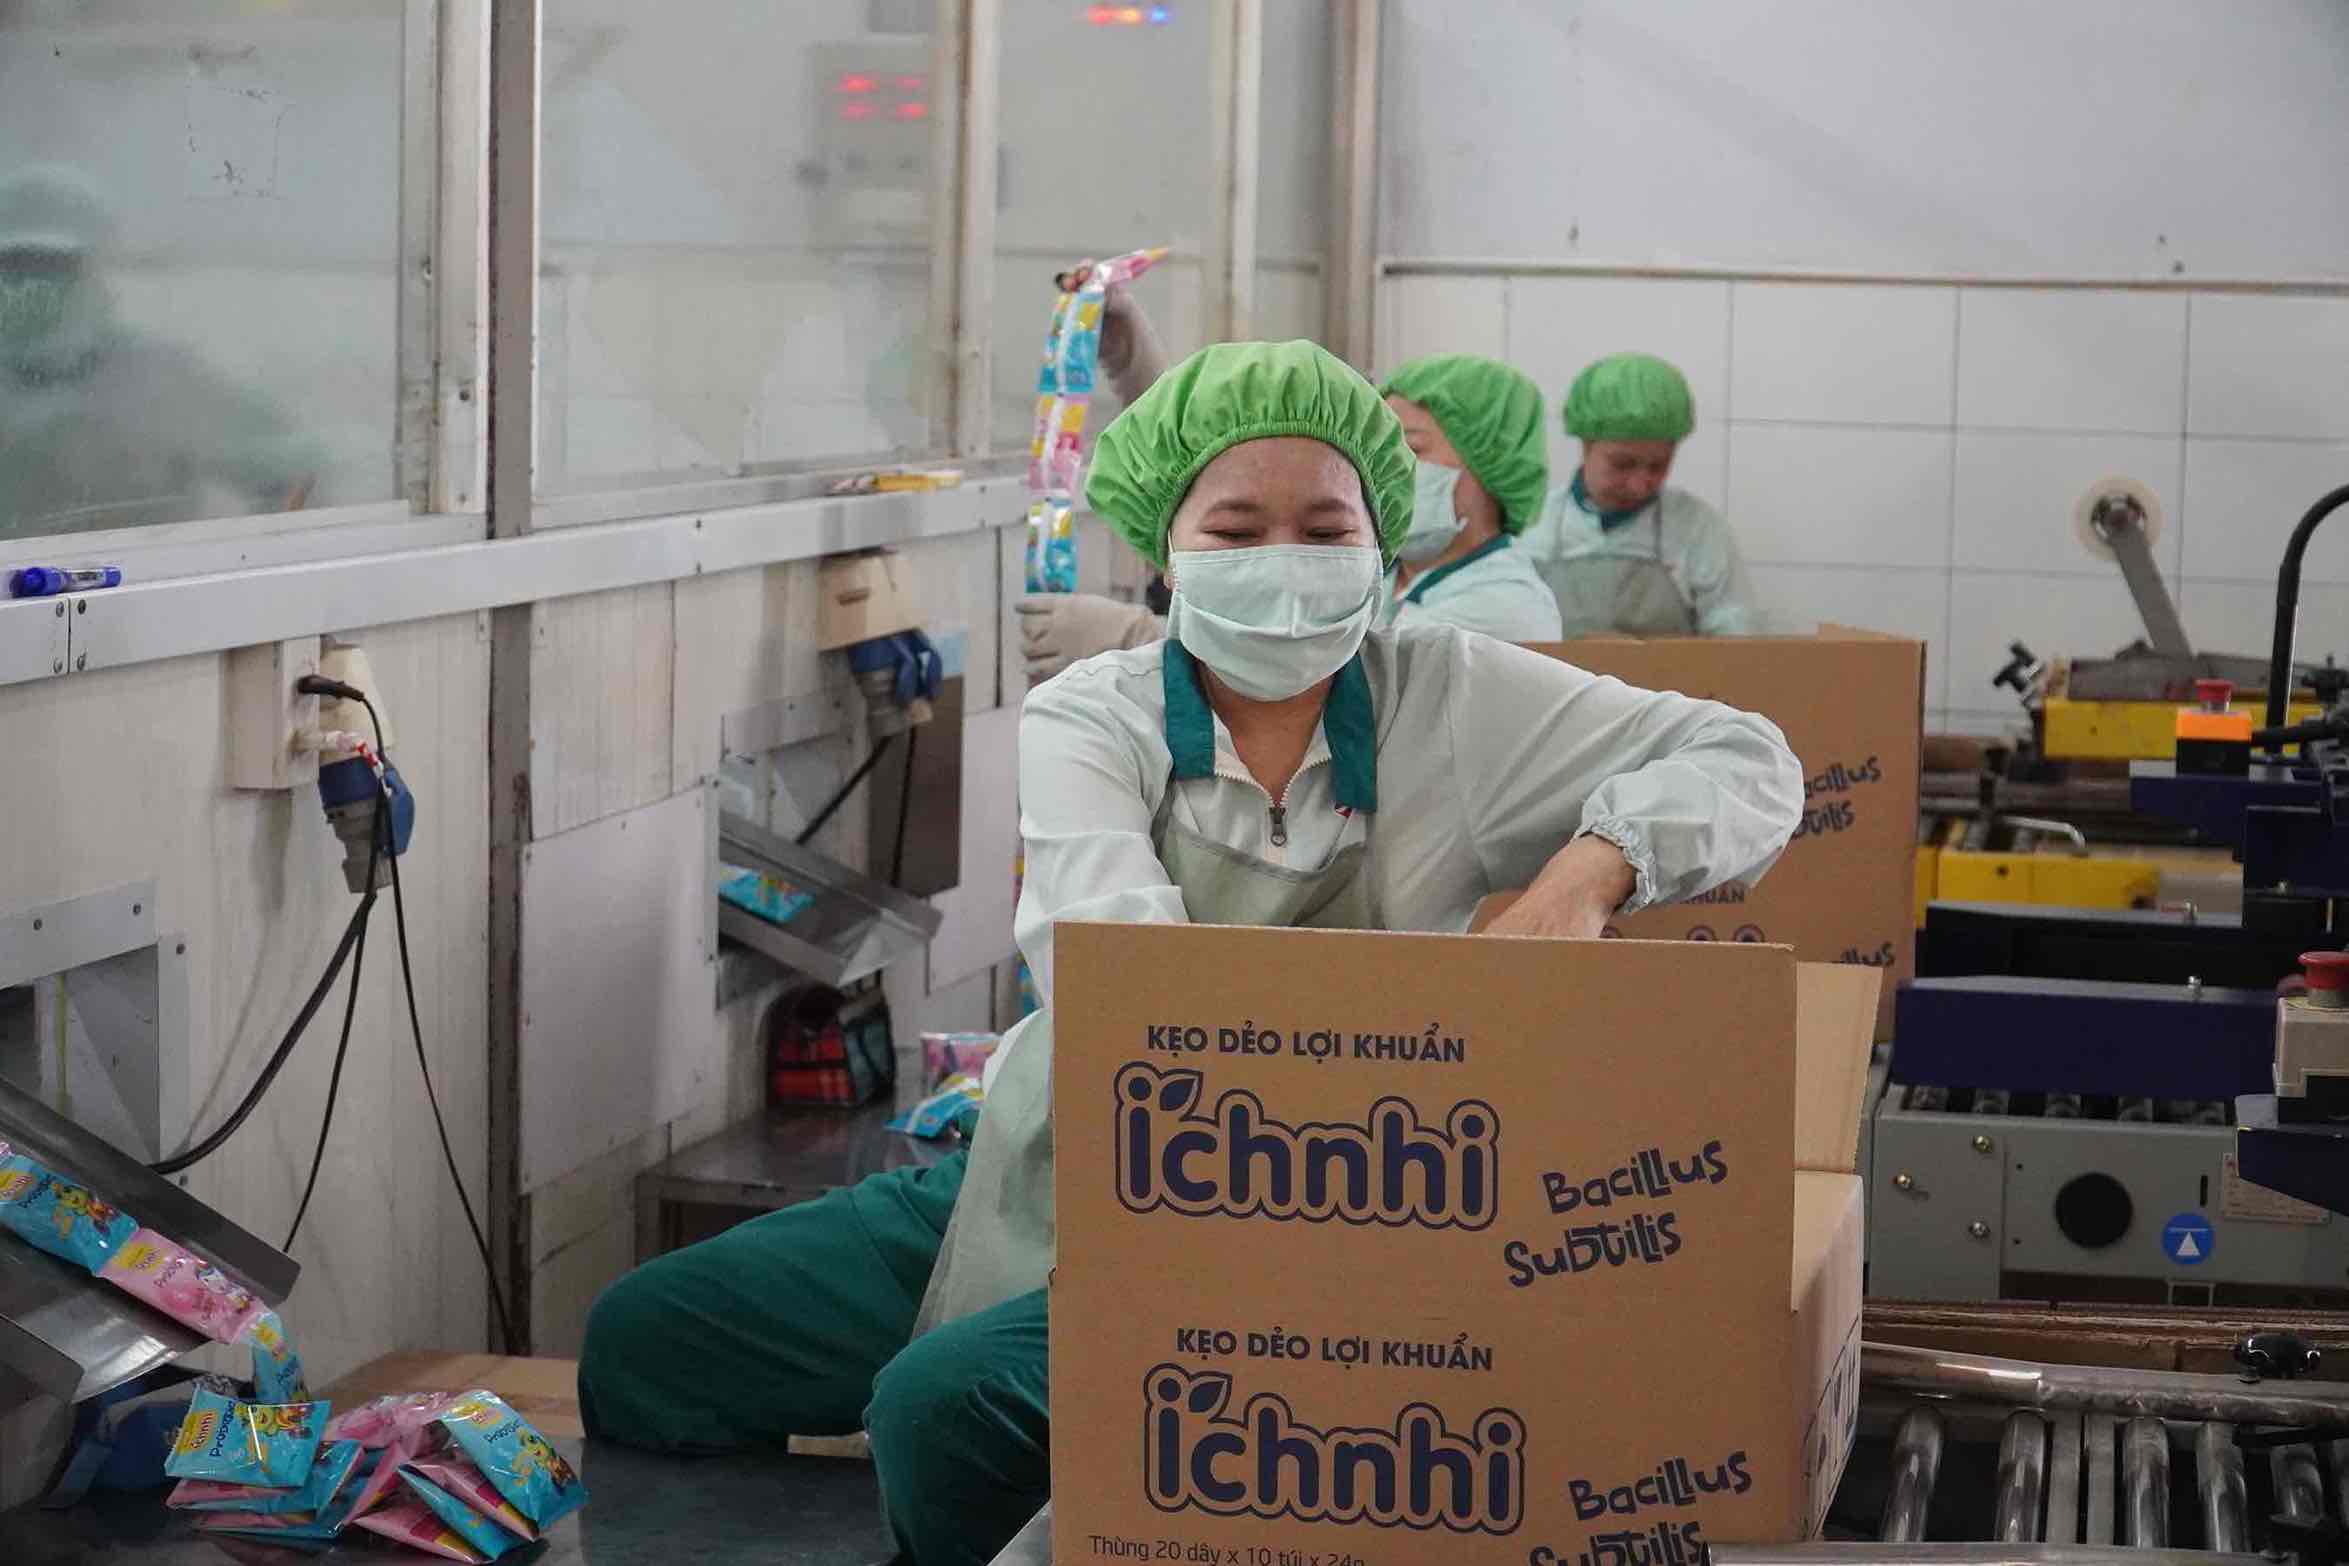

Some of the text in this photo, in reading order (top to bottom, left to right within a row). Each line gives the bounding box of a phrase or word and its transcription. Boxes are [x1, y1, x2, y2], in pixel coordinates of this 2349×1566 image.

[1147, 1020, 1465, 1064] KẸO DẺO LỢI KHUẨN
[1177, 1326, 1493, 1371] KẸO DẺO LỢI KHUẨN
[1088, 1535, 1149, 1560] Thùng
[1156, 1540, 1181, 1560] 20
[1187, 1543, 1221, 1566] dây
[1227, 1550, 1239, 1565] x
[1248, 1548, 1271, 1566] 10
